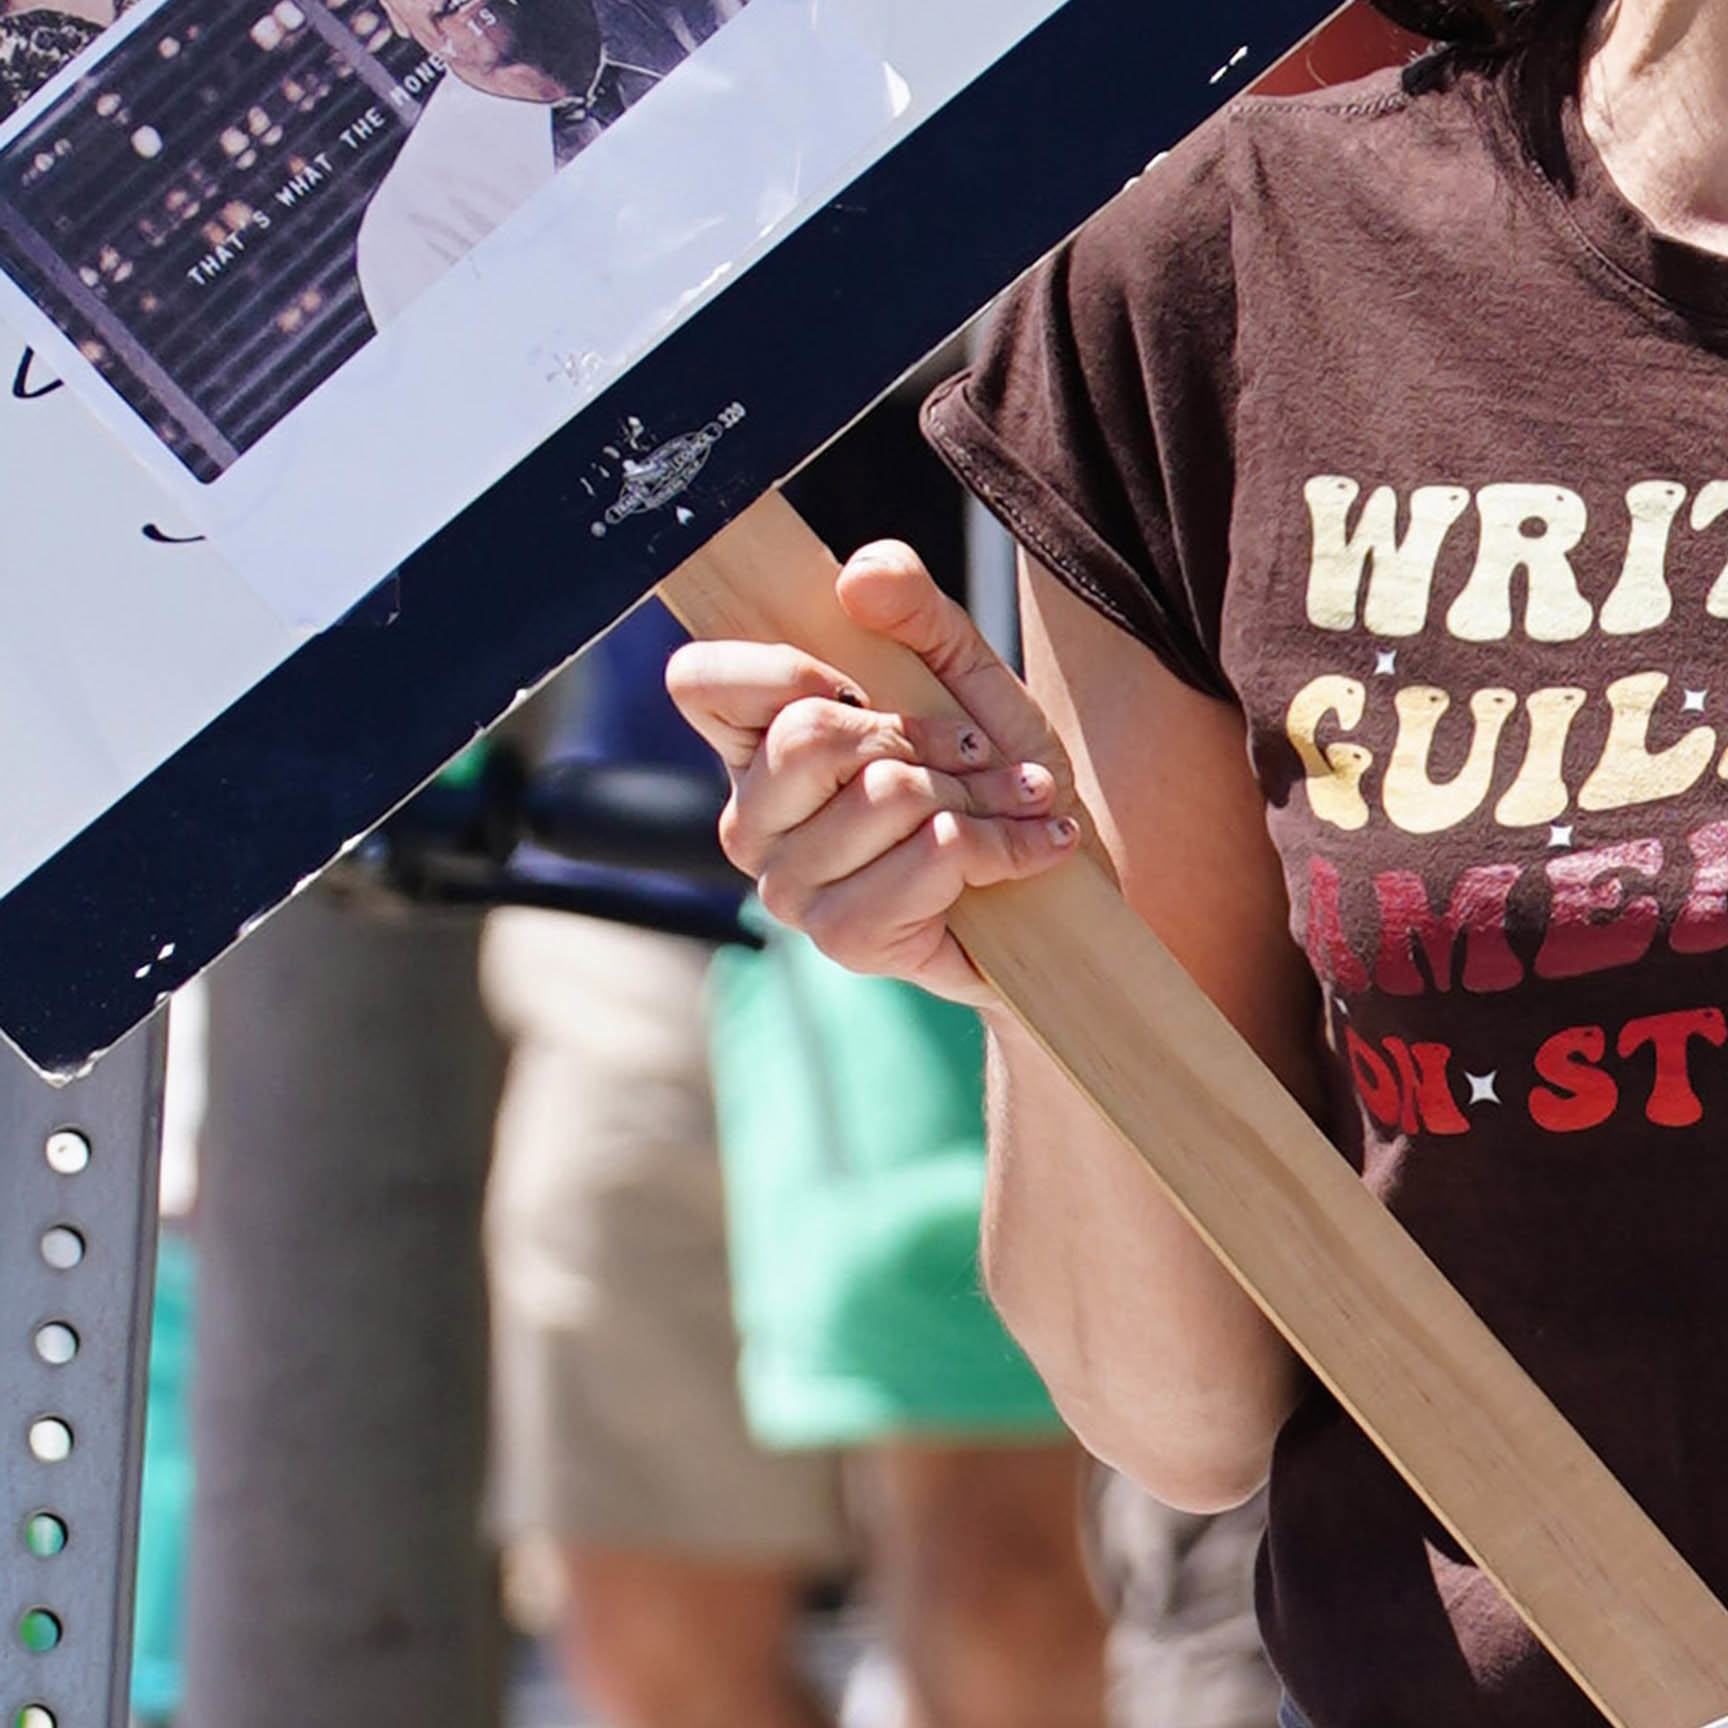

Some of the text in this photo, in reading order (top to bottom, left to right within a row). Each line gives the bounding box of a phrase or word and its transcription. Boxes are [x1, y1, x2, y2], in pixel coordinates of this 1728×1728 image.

[187, 209, 272, 286] THAT'S
[275, 152, 334, 209] WHAT
[339, 106, 386, 150] THE
[390, 39, 457, 107] MONEY
[466, 7, 498, 38] IS
